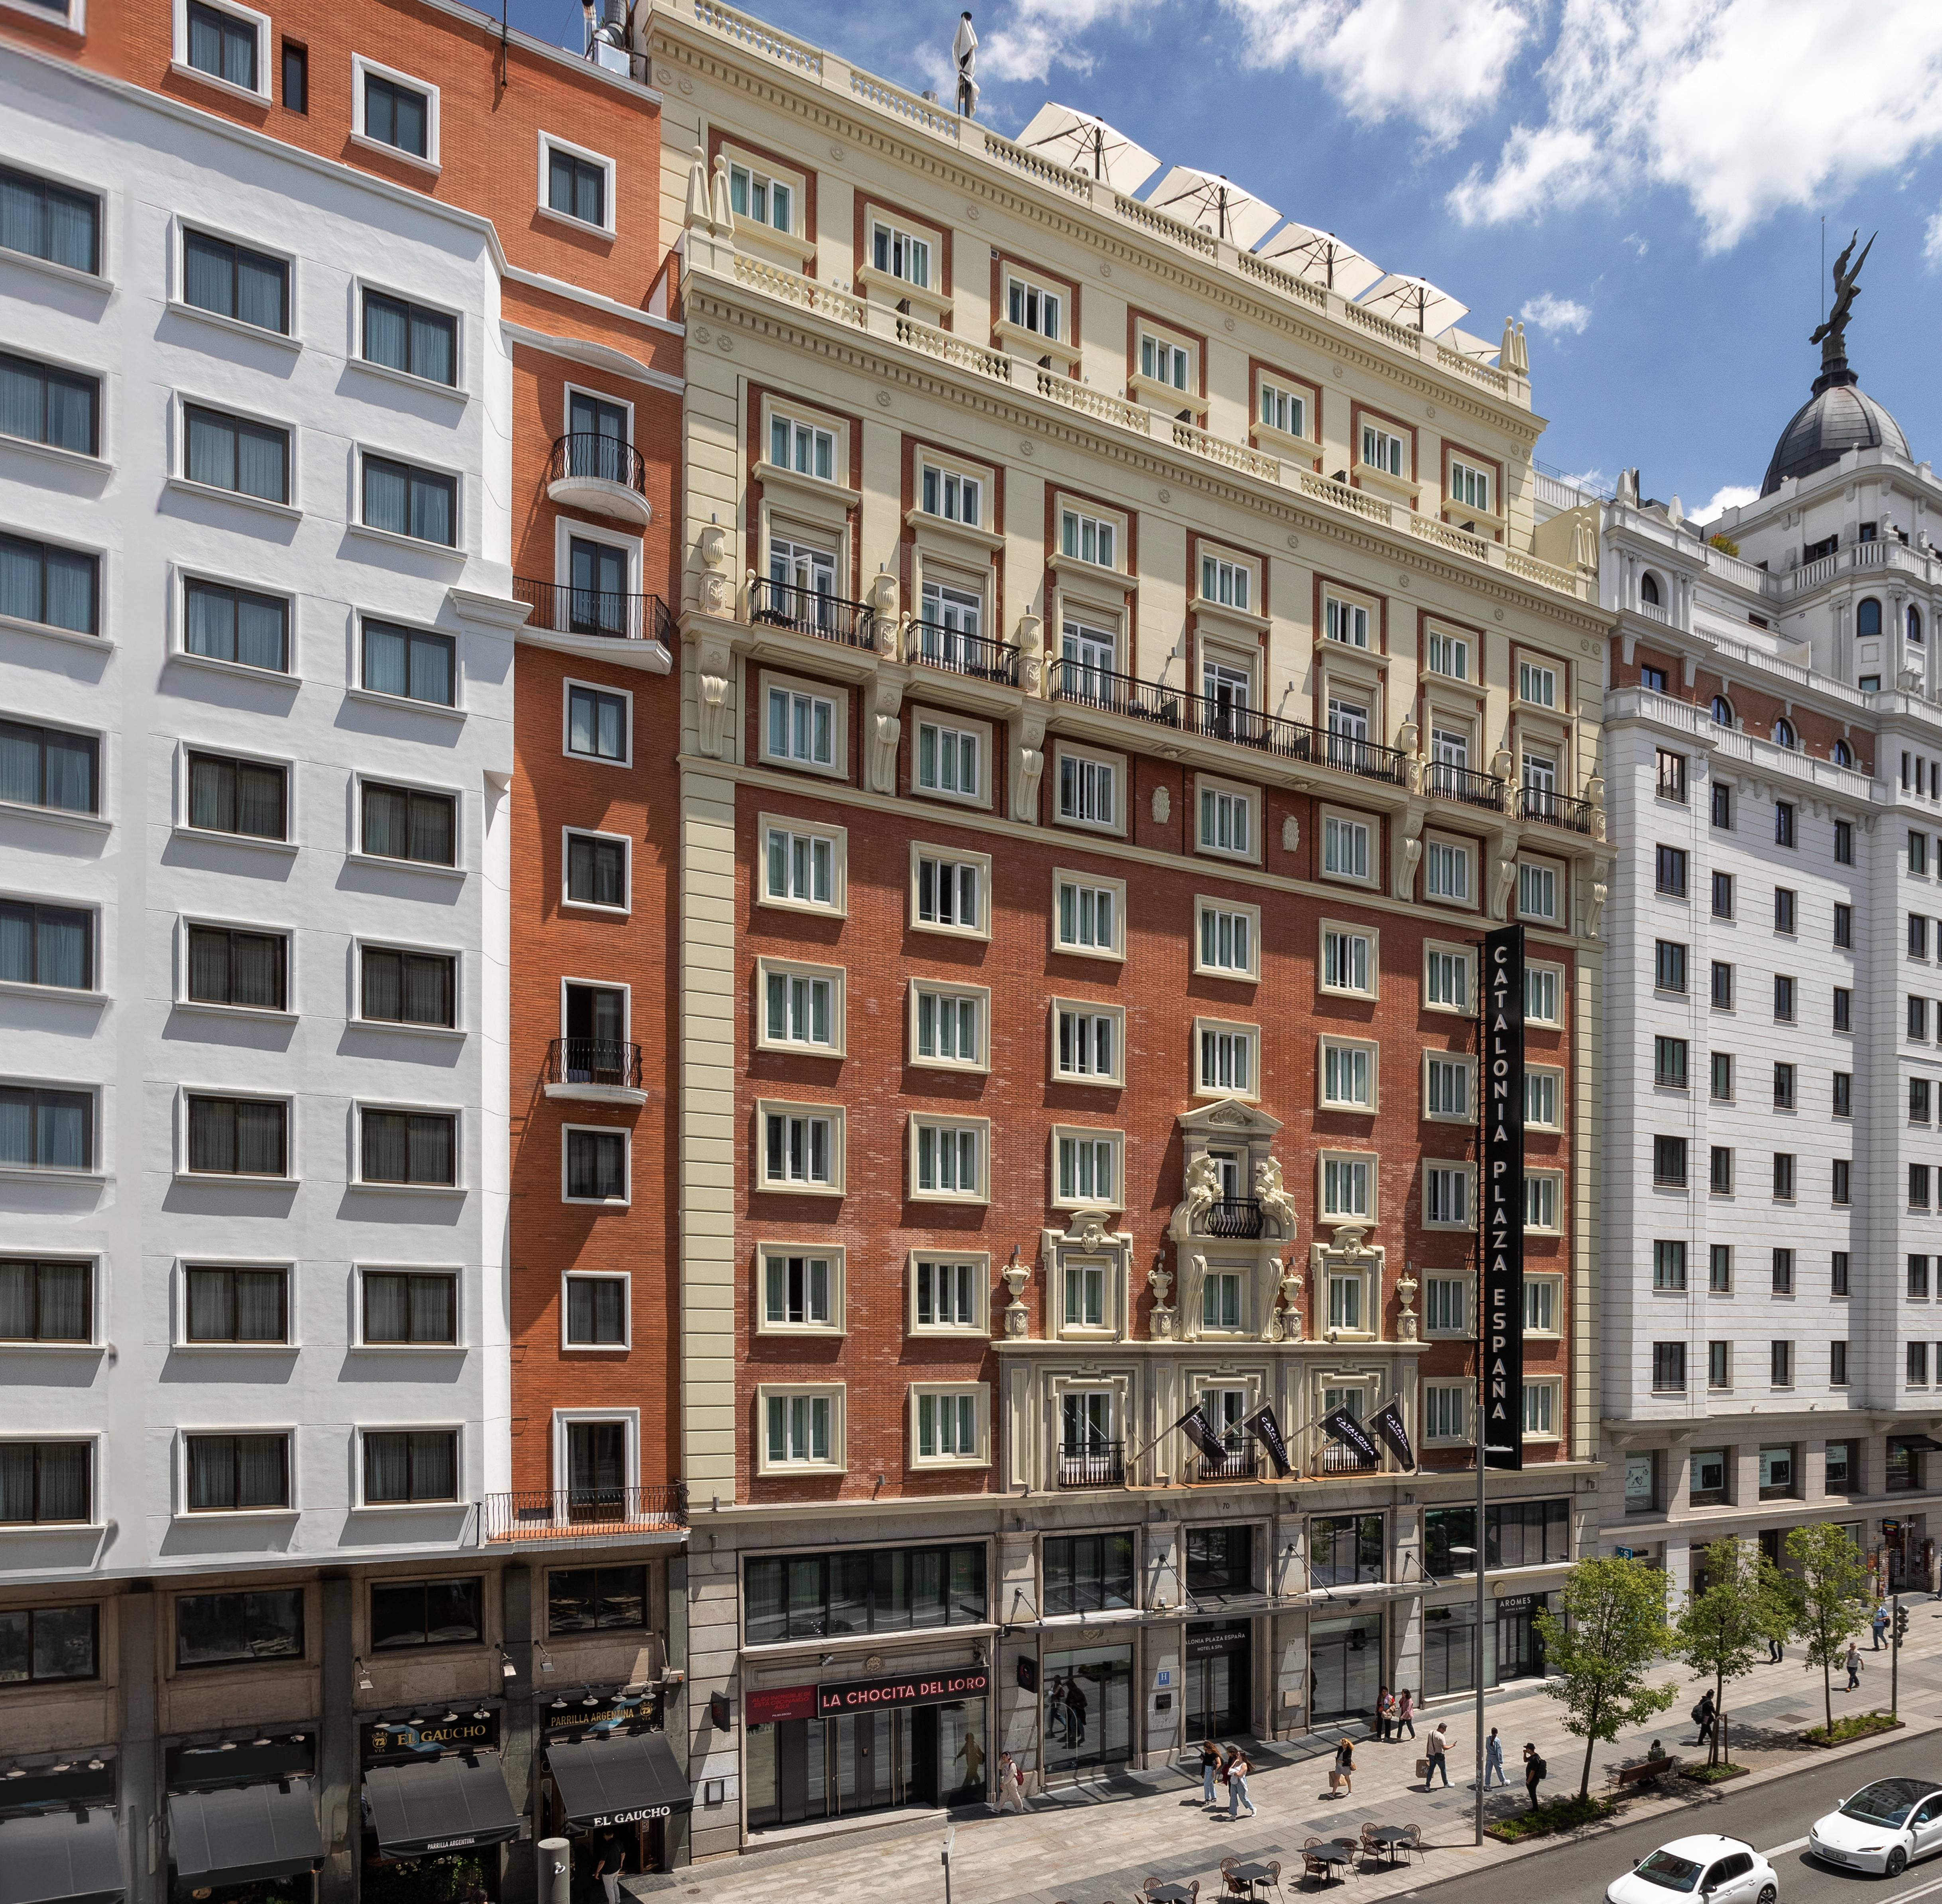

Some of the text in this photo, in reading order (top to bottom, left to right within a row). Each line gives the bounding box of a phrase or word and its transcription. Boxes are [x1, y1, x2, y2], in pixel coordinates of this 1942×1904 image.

[1492, 946, 1508, 1420] CATALONIA PLAZA ESPAÑA
[1336, 1417, 1374, 1456] CATALONIA
[1338, 1424, 1351, 1434] HOTELS
[1354, 1437, 1367, 1451] RESORTS
[1388, 1423, 1399, 1436] HOTELS
[1261, 1417, 1290, 1466] CATALONIA
[1500, 1597, 1531, 1607] AROMES
[771, 1696, 809, 1705] COCINANDO
[822, 1676, 986, 1708] LA CHOCITA DEL LORO
[551, 1708, 634, 1726] PARRILLA ARGENTINA
[374, 1737, 386, 1747] 72
[397, 1725, 486, 1746] EL GAUCHO
[594, 1806, 671, 1827] EL GAUCHO
[427, 1837, 475, 1850] PARRILLA ARGENTINA
